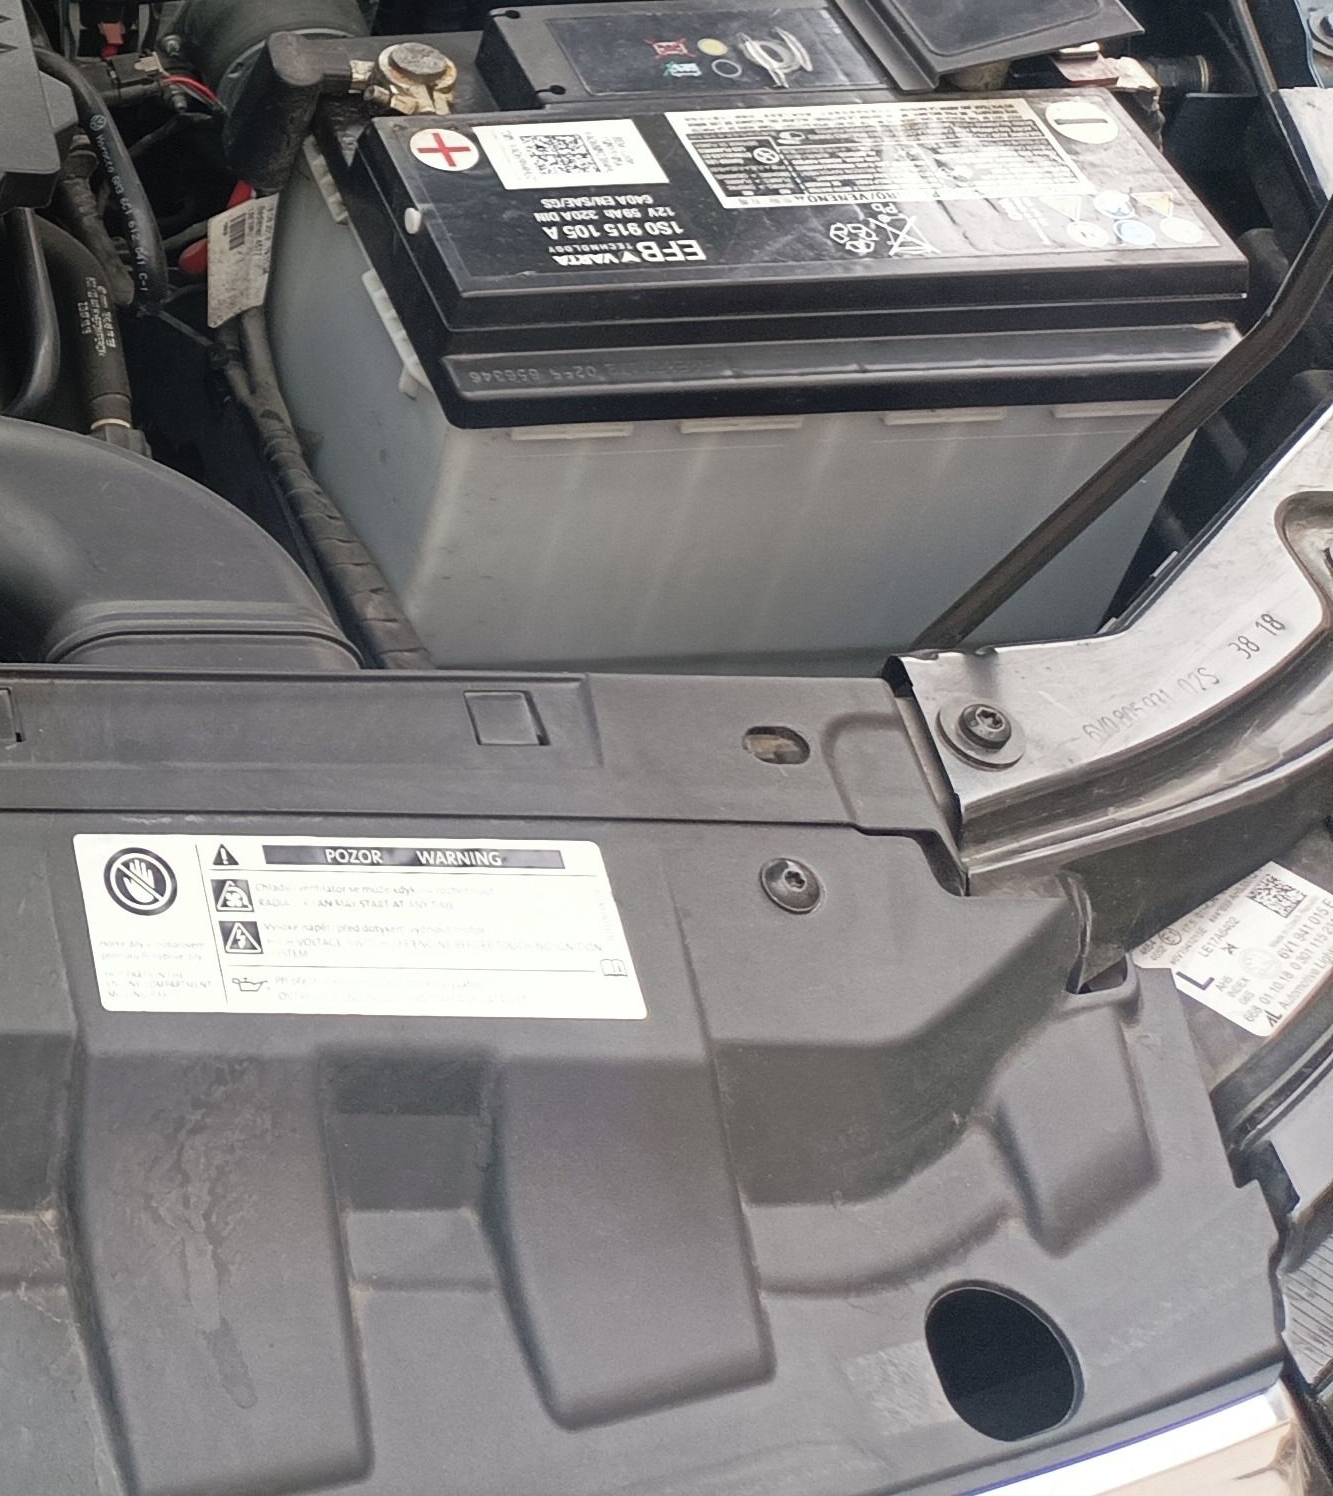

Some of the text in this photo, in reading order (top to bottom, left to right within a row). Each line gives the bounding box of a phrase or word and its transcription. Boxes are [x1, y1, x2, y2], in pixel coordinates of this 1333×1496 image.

[613, 193, 652, 206] 640A
[533, 206, 675, 221] 12V 59Ah 320A DIN
[541, 225, 557, 239] A
[561, 223, 599, 238] 105
[603, 221, 641, 236] 915
[548, 241, 633, 252] TECHNOLOGY
[552, 239, 706, 265] EFB VARTA
[1227, 630, 1261, 663] 38
[1252, 607, 1286, 642] 18
[325, 848, 503, 866] POZOR WARNING
[1175, 961, 1215, 991] L
[1278, 965, 1320, 1011] Automotive
